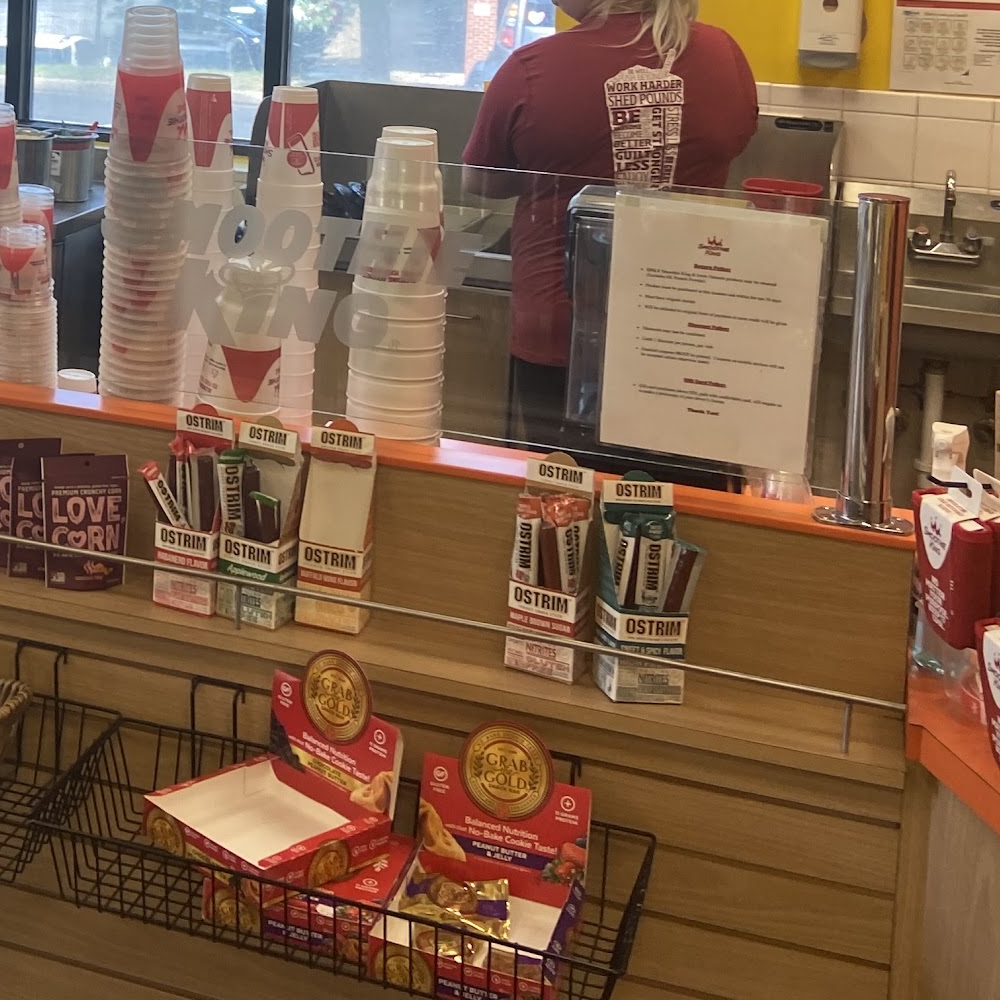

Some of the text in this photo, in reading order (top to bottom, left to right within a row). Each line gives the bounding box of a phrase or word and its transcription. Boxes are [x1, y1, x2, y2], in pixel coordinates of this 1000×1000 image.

[606, 80, 682, 92] WORK HARDER
[608, 92, 683, 107] SHED POUNDS
[611, 109, 640, 126] BE
[652, 107, 662, 129] GET
[614, 139, 652, 148] BETTER
[615, 150, 651, 161] GUILT
[616, 160, 650, 172] LESS
[186, 414, 224, 432] OSTRIM
[249, 426, 287, 446] OSTRIM
[320, 431, 363, 450] OSTRIM
[539, 463, 583, 484] OSTRIM
[80, 488, 107, 496] CRUNCHY
[225, 465, 242, 520] OSTRIM
[616, 483, 662, 499] OSTRIM
[51, 495, 122, 525] LOVE
[51, 523, 120, 551] CORN
[160, 528, 207, 551] OSTRIM
[519, 522, 533, 569] OSTRIM
[224, 539, 271, 565] OSTRIM
[304, 546, 357, 570] OSTRIM
[226, 563, 268, 581] Applewood
[645, 544, 661, 591] OSTRIM
[514, 586, 569, 614] OSTRIM
[509, 611, 528, 624] MAPLE
[551, 621, 571, 634] SUGAR
[626, 618, 682, 636] OSTRIM
[525, 641, 557, 657] NITRITES
[321, 677, 353, 701] GRAB
[317, 692, 350, 717] GOLD
[302, 731, 357, 766] Balanced Nutrition
[331, 754, 352, 772] Cookie
[486, 752, 528, 773] GRAB
[483, 770, 527, 790] GOLD
[465, 815, 539, 841] Balanced Nutrition
[468, 825, 558, 856] No-Bake Cookie Taste!
[471, 840, 528, 860] PEANUT BUTTER
[493, 852, 513, 862] JELLY
